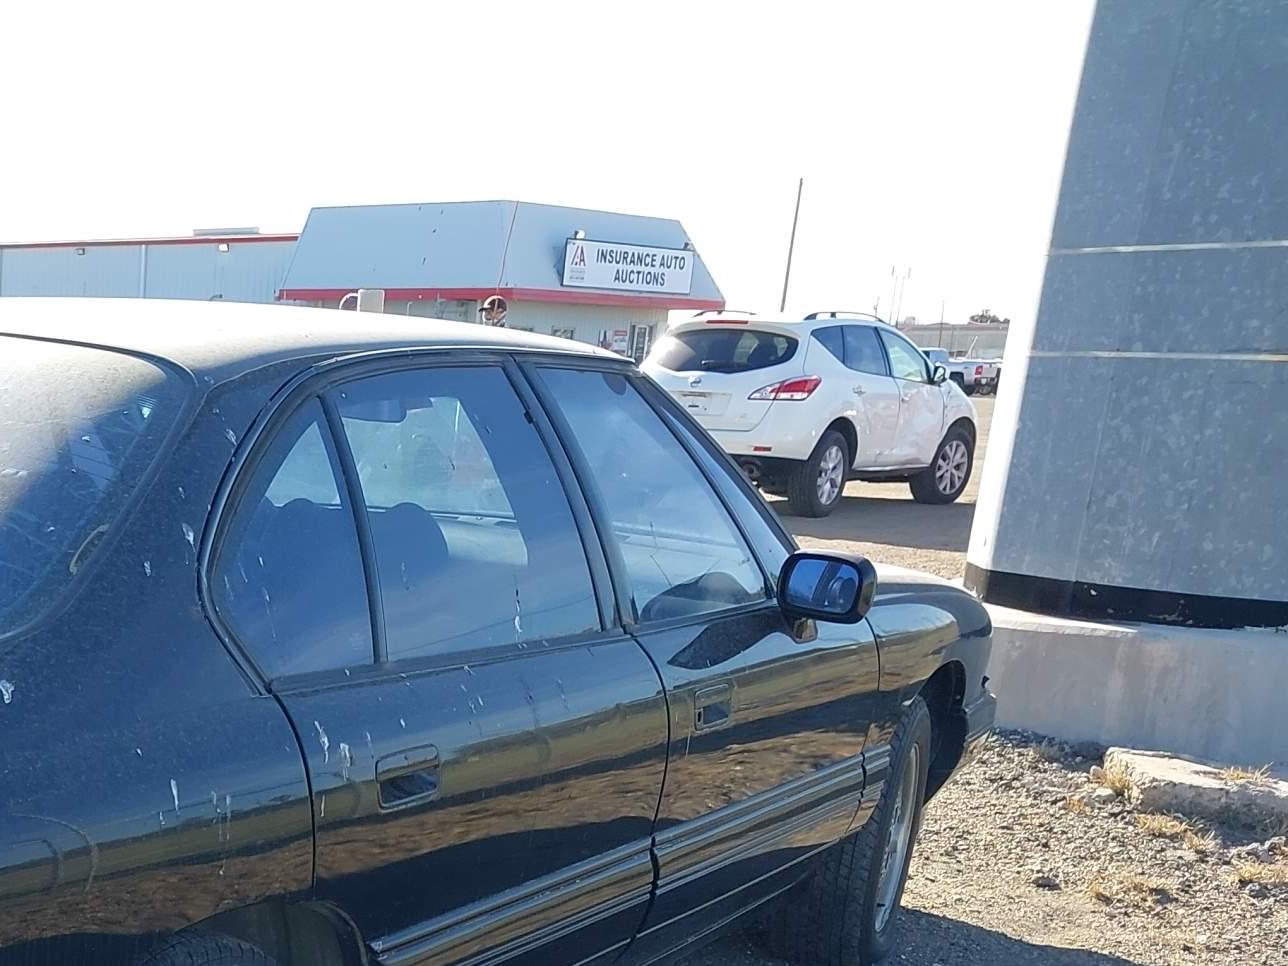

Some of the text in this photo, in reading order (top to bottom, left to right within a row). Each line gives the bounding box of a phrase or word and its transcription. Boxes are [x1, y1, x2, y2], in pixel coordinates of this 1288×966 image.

[596, 247, 686, 271] INSURANCE AUTO
[613, 268, 666, 287] AUCTIONS
